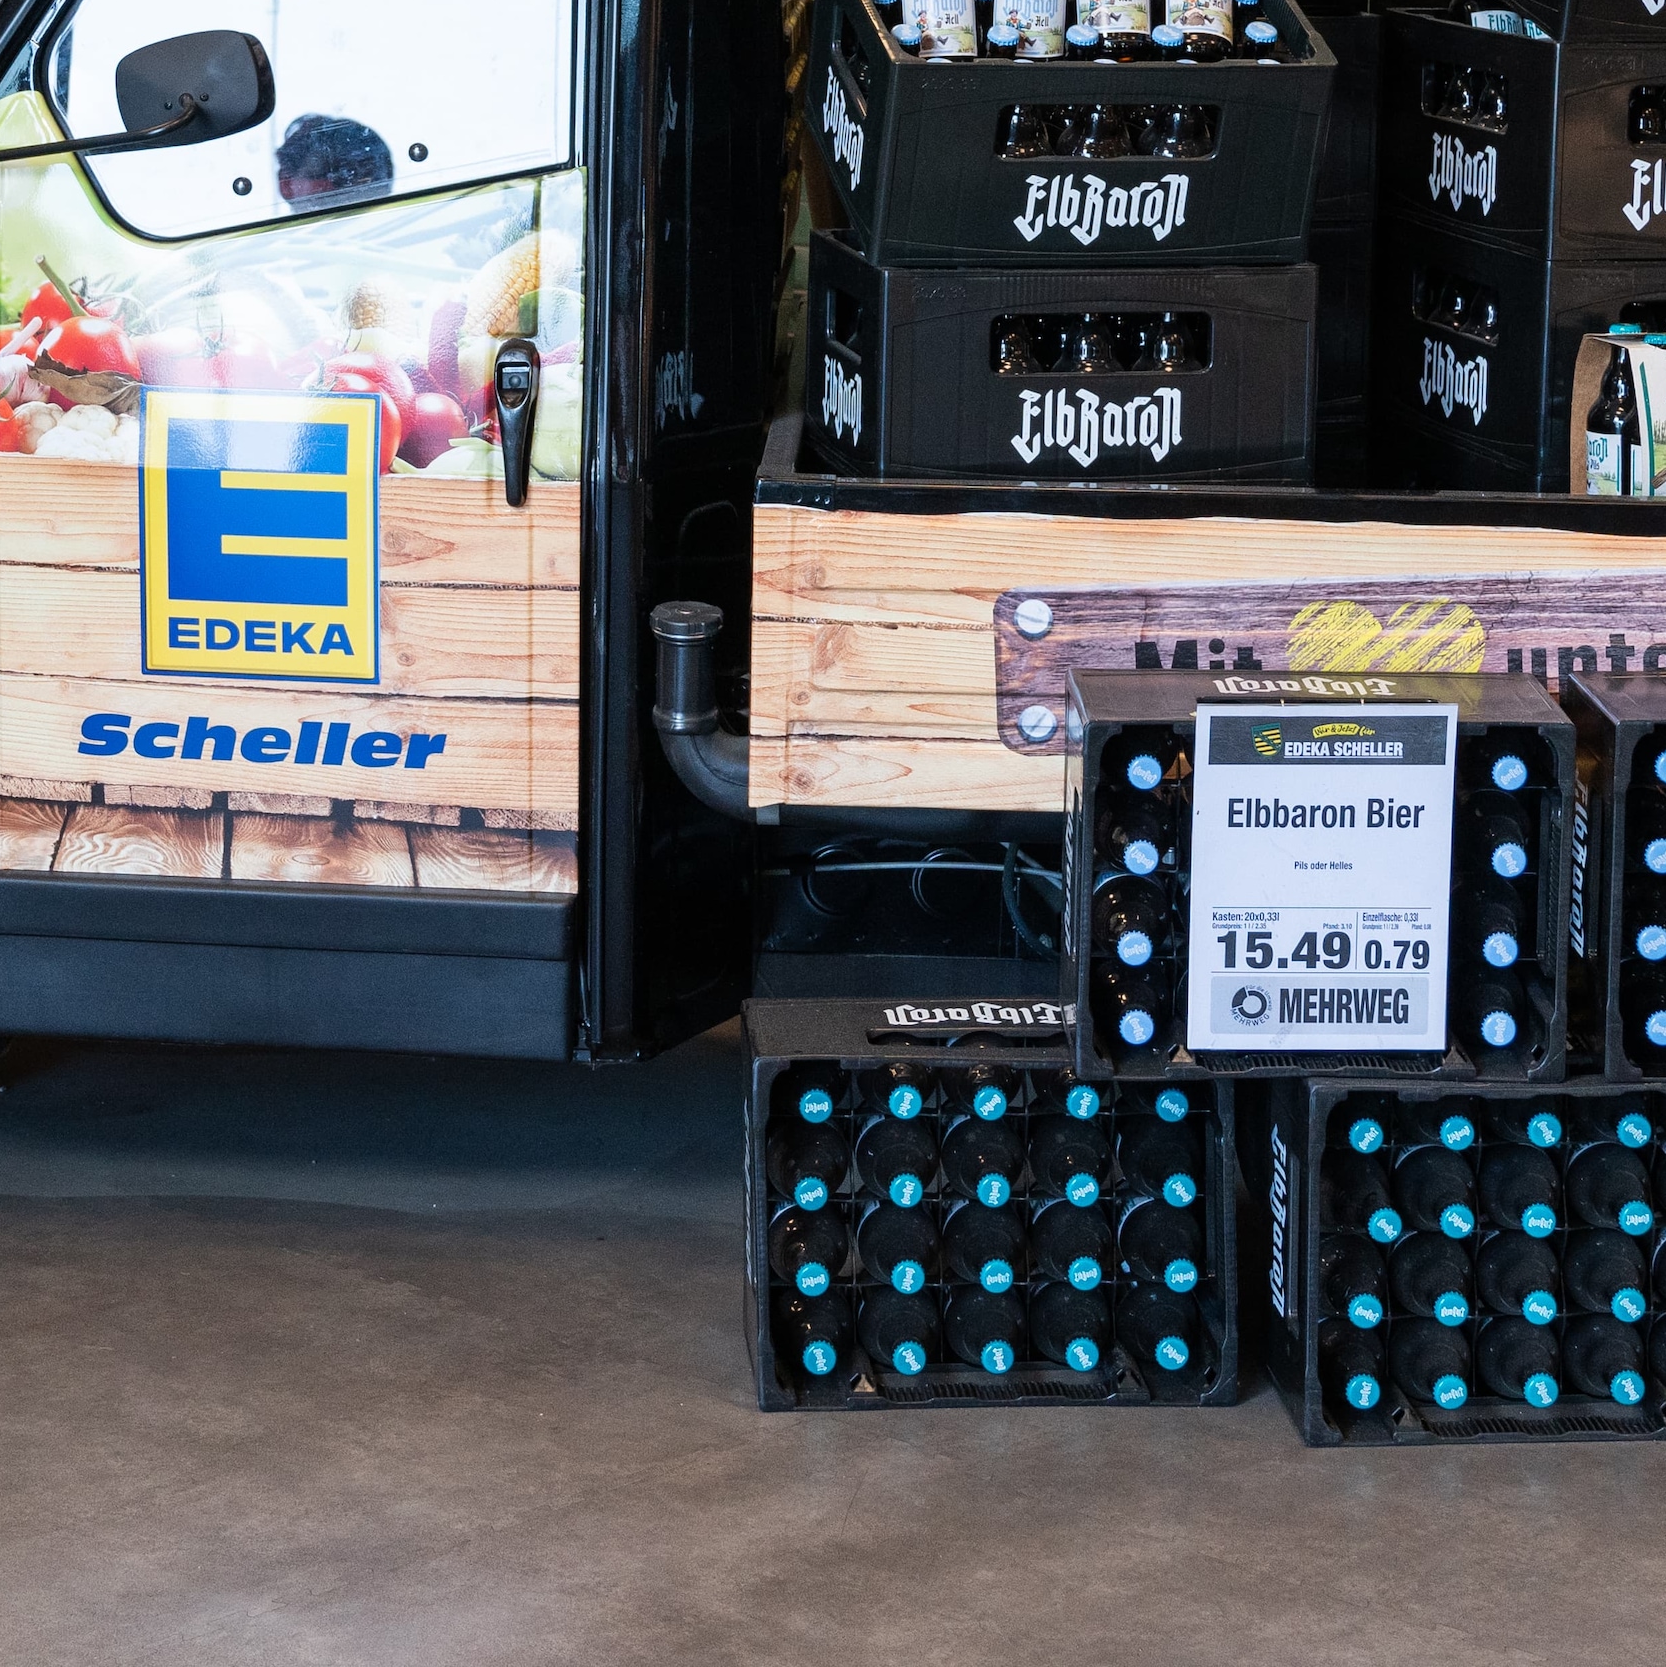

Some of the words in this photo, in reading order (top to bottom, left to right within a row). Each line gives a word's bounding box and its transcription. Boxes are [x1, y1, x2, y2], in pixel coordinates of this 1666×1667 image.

[1013, 174, 1190, 246] ElbBaron
[1010, 387, 1183, 469] ElbBaron
[168, 616, 355, 656] EDEKA
[77, 712, 447, 770] Scheller
[1284, 741, 1330, 757] EDEKA
[1333, 741, 1404, 757] SCHELLER
[1227, 798, 1356, 829] Elbbaron
[1366, 798, 1425, 829] Bier
[1294, 861, 1308, 871] Pils
[1310, 861, 1327, 871] oder
[1329, 861, 1353, 871] Helles
[1212, 912, 1244, 922] Kasten:
[1244, 912, 1280, 922] 20x0,33l
[1362, 912, 1403, 922] Einzelflasche:
[1404, 912, 1419, 922] 0,33l
[1217, 930, 1352, 970] 15.49
[1364, 939, 1430, 970] 0.79
[1231, 1009, 1271, 1027] MEHRWEG
[1278, 988, 1410, 1024] MEHRWEG
